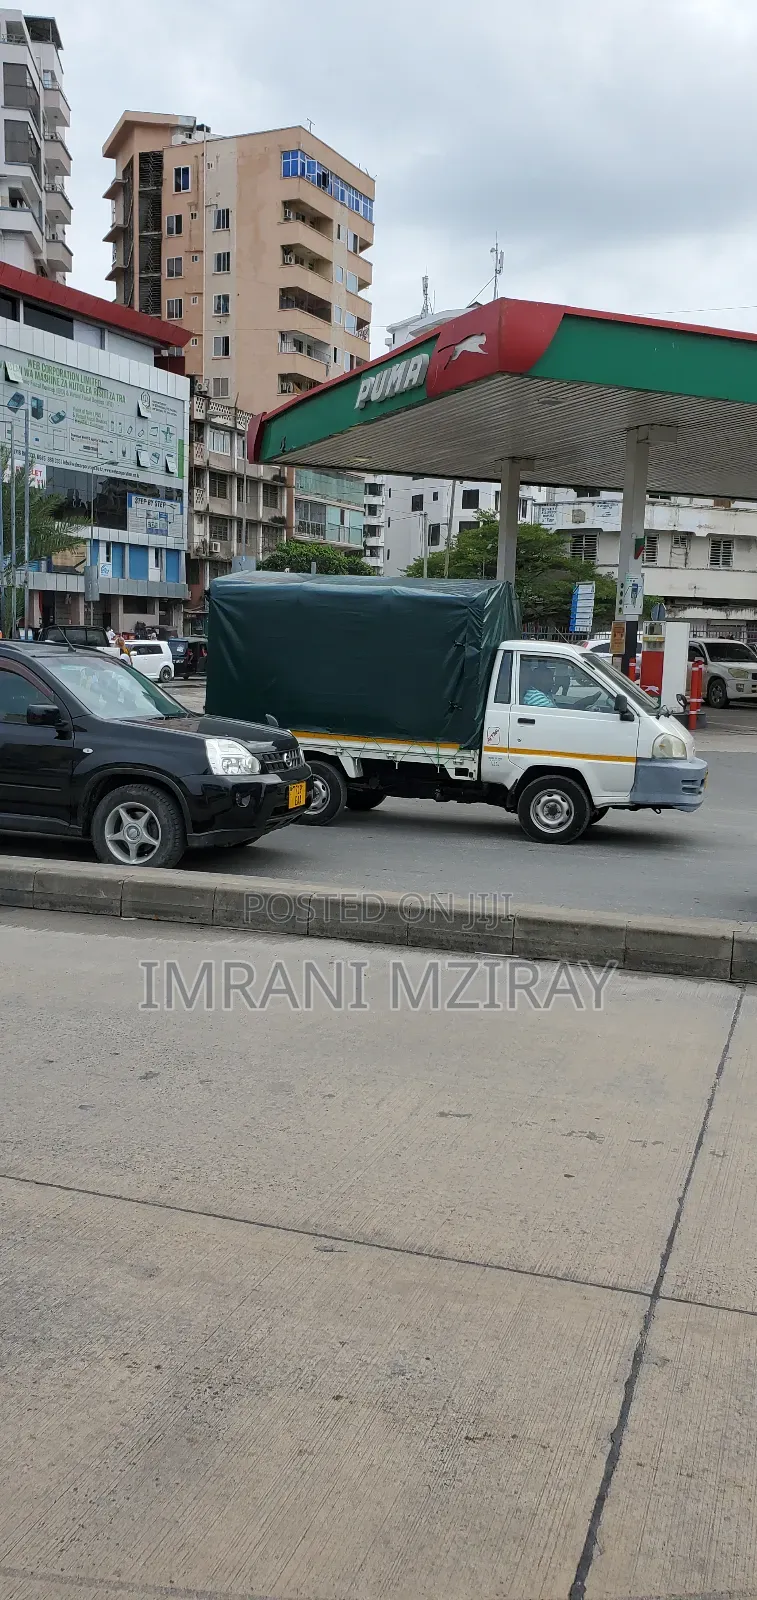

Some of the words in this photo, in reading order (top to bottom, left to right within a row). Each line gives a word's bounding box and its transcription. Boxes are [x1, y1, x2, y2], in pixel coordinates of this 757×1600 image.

[27, 358, 41, 370] WEB
[41, 362, 80, 382] CORPORATION
[80, 374, 102, 388] LIMITED
[354, 353, 430, 409] PUMA
[135, 496, 147, 505] STEP
[154, 500, 166, 508] STEP
